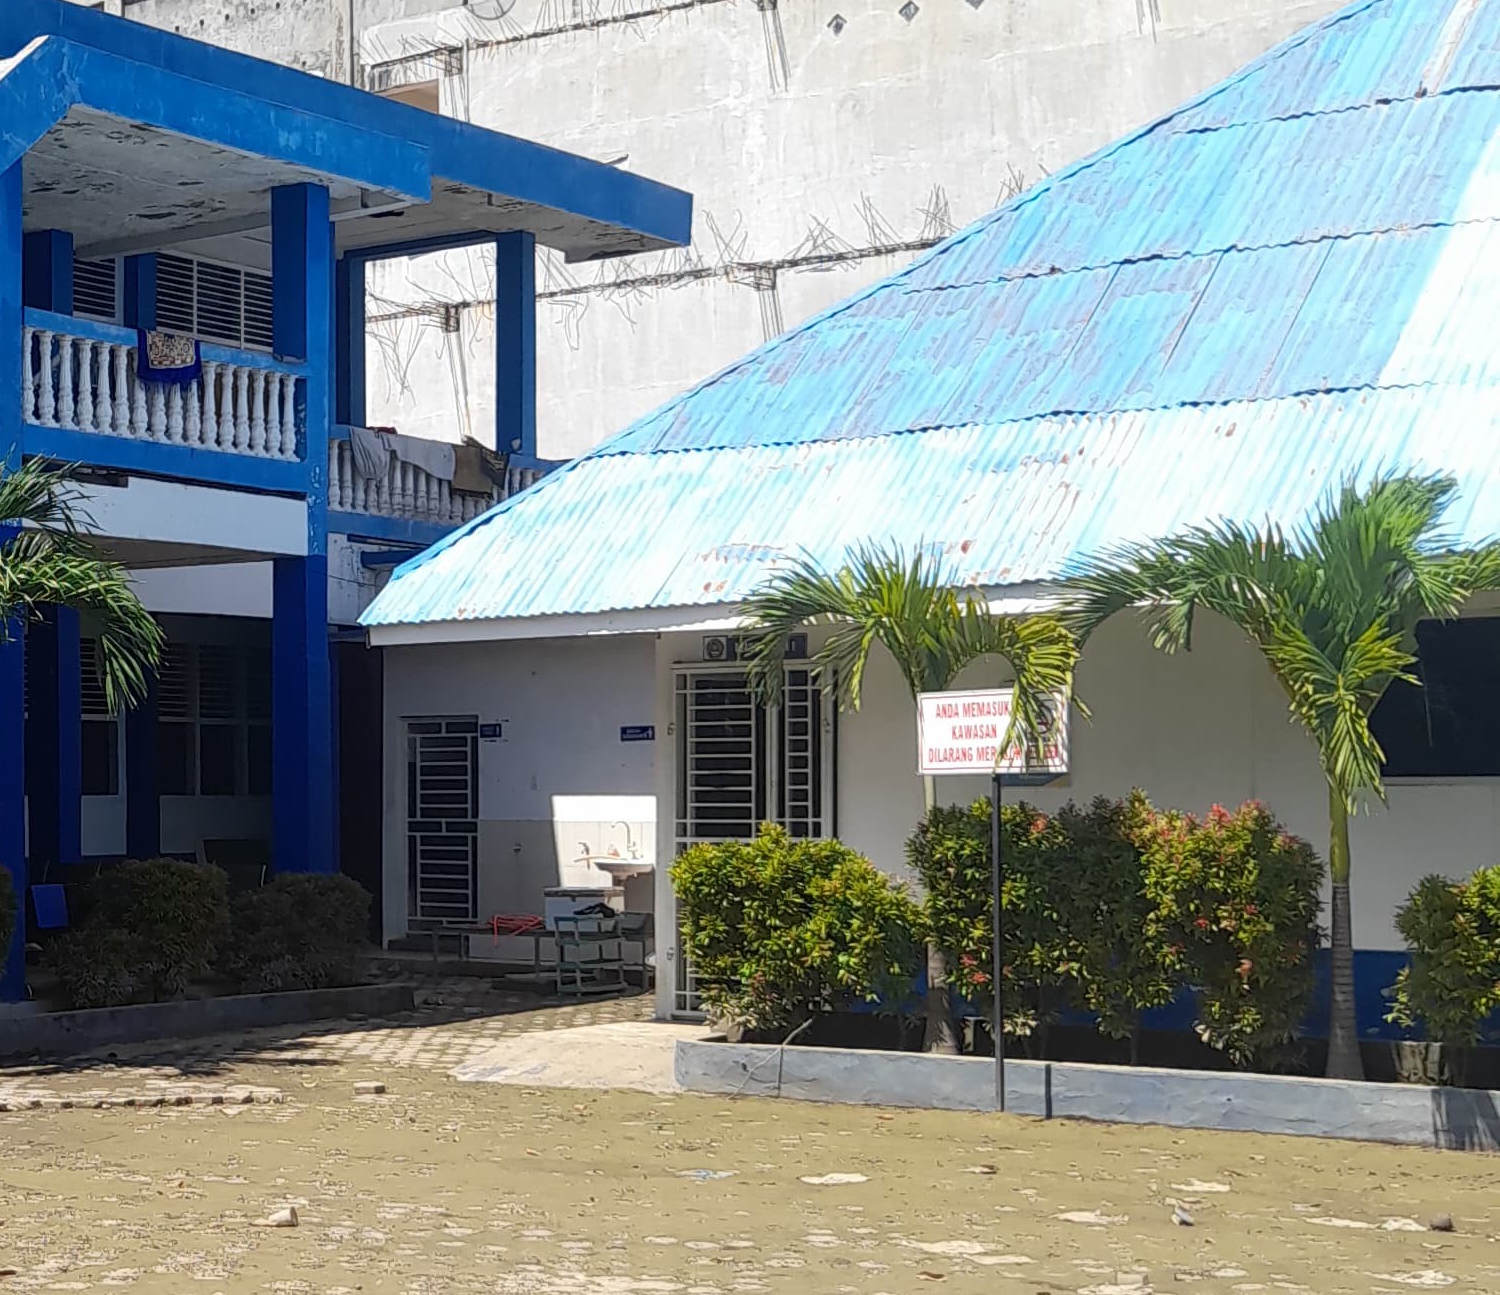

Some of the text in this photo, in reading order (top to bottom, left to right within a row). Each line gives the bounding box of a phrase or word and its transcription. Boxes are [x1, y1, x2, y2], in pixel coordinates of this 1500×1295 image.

[935, 700, 1013, 719] ANDA MEMASUK
[951, 723, 998, 741] KAWASAN
[928, 747, 974, 764] DILARANG
